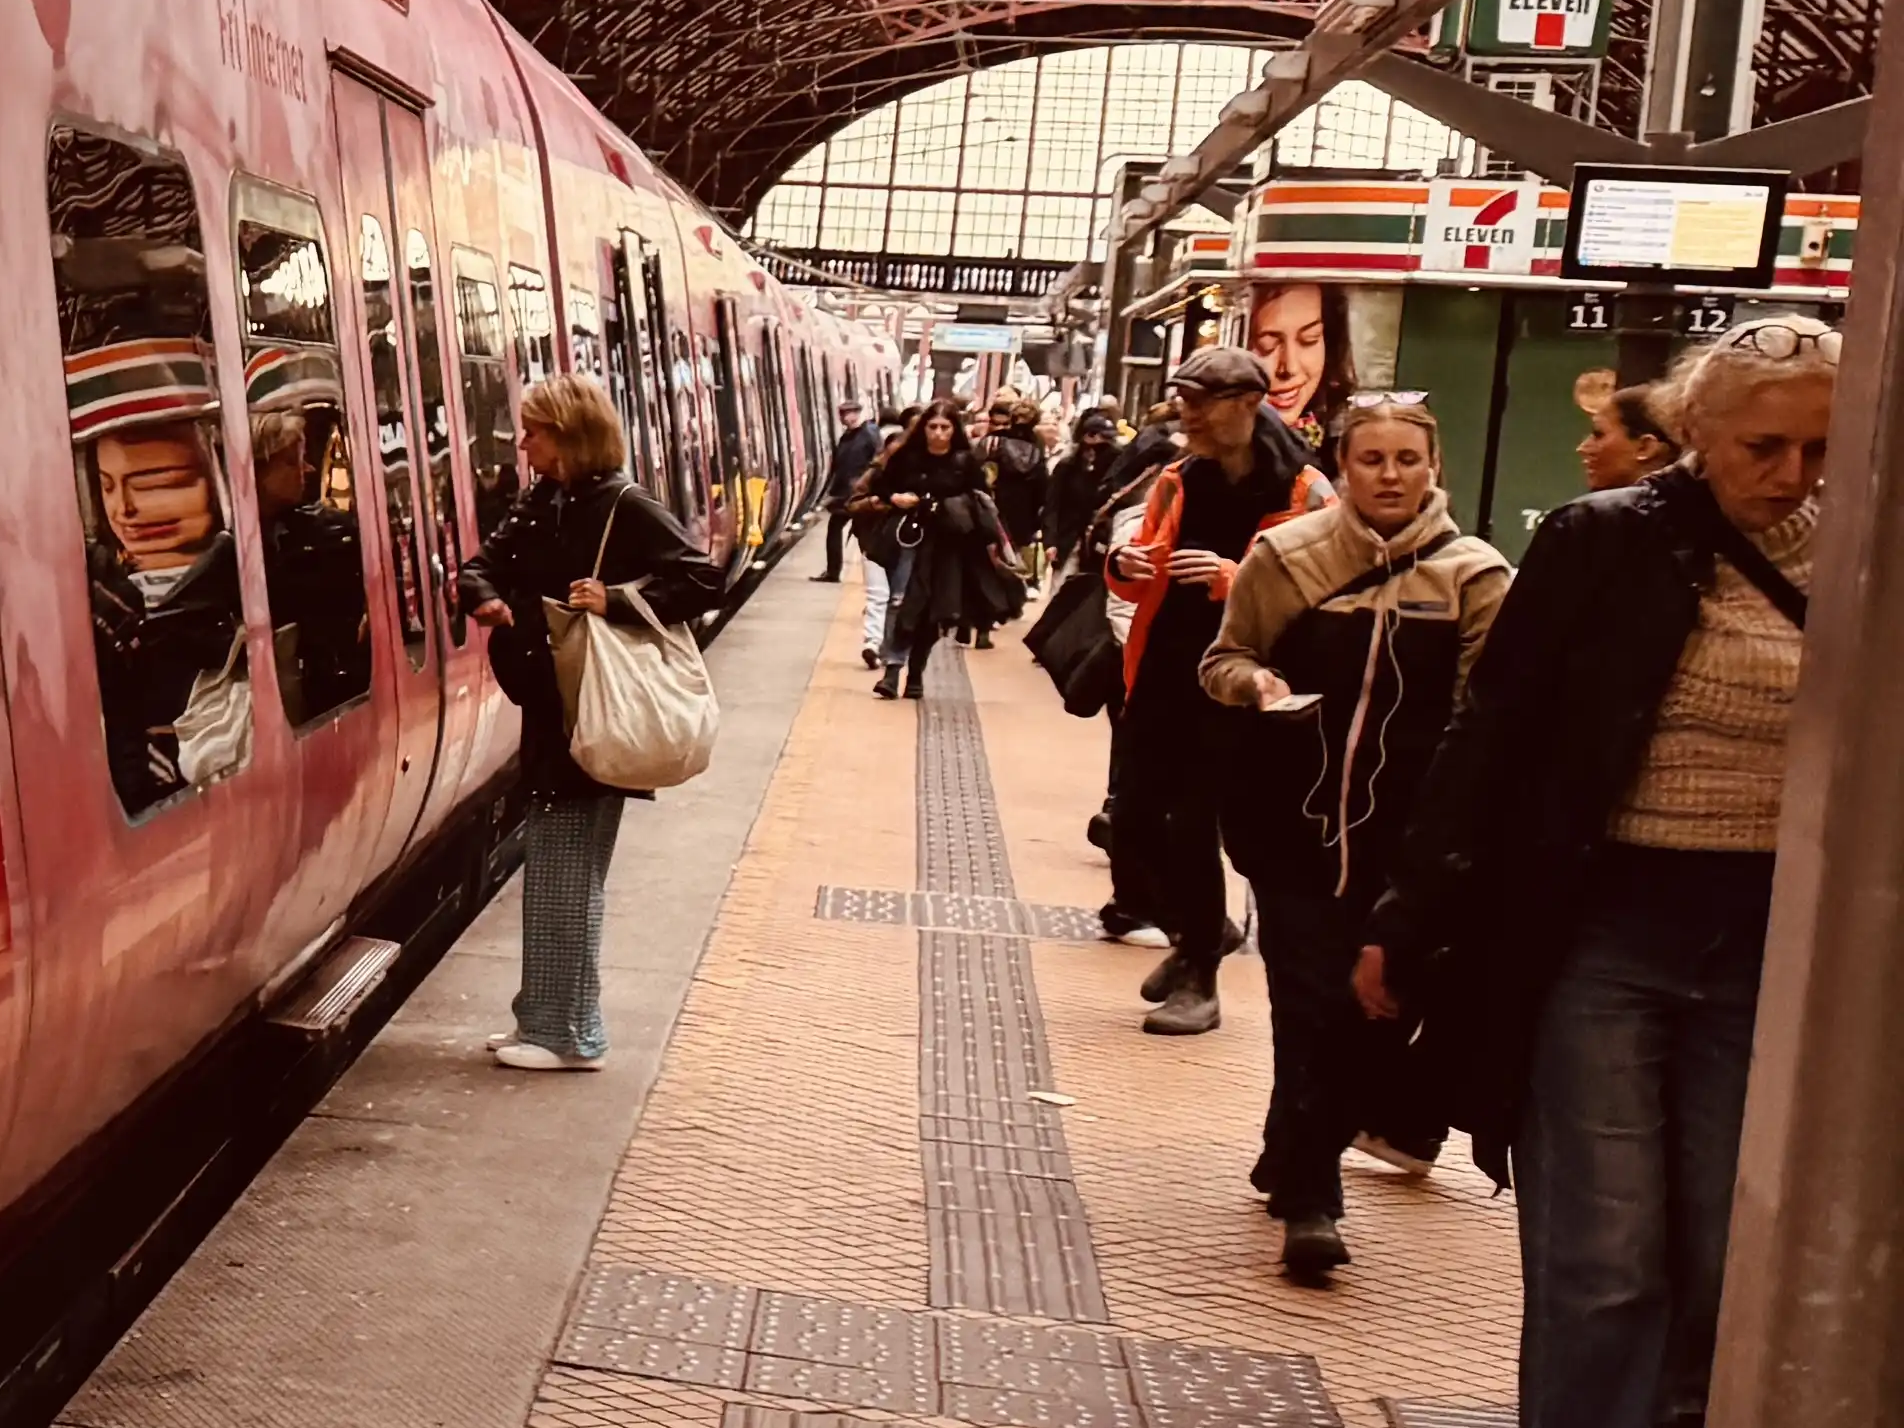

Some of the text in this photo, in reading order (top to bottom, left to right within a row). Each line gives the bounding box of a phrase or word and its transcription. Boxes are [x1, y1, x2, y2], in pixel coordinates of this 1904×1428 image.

[1448, 187, 1519, 270] 7
[1569, 305, 1608, 329] 11
[1688, 309, 1728, 333] 12
